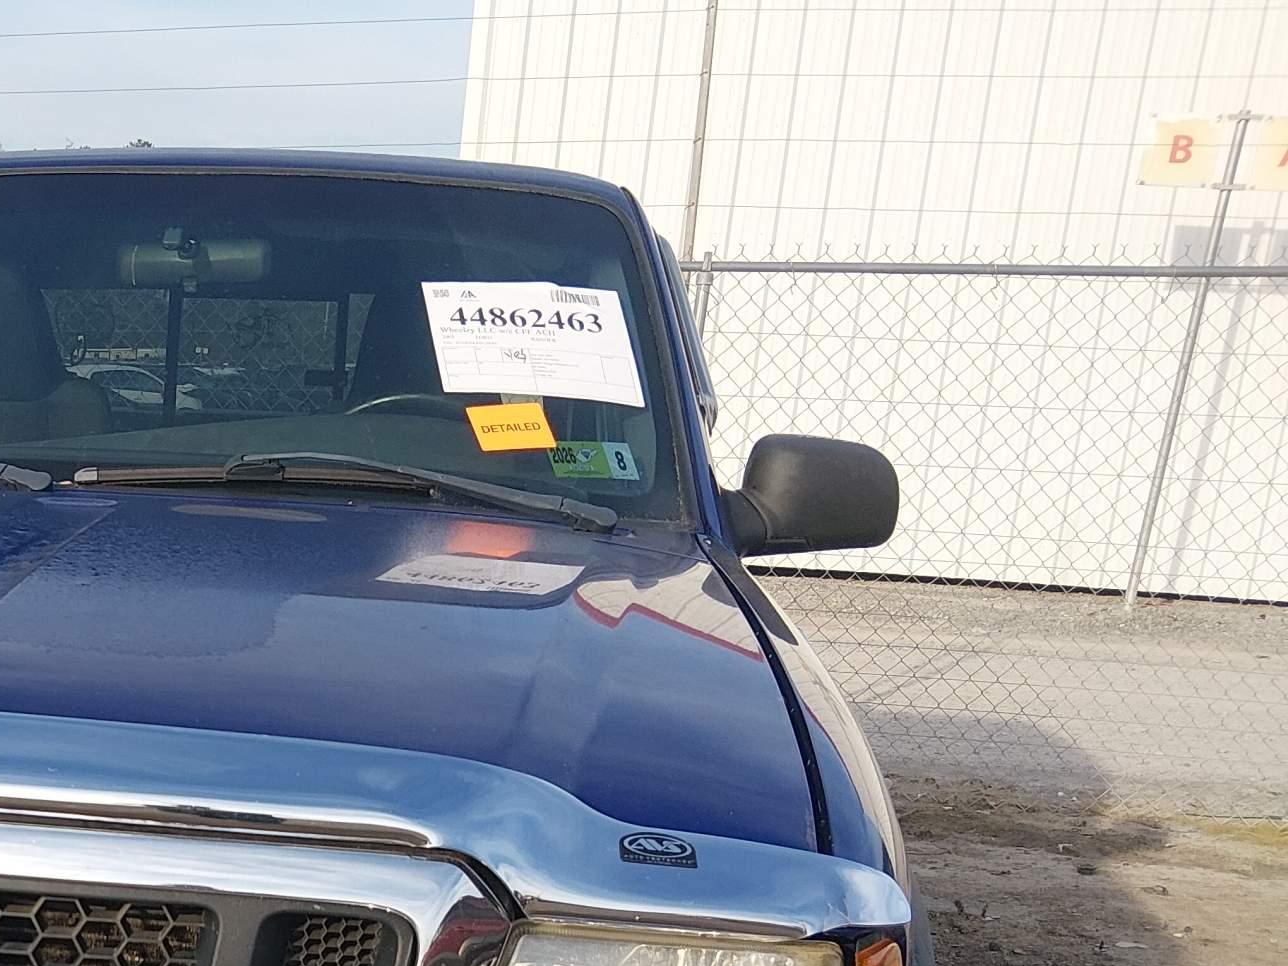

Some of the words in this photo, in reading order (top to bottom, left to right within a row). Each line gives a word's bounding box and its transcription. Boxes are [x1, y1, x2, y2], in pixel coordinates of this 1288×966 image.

[1168, 134, 1195, 164] B
[450, 306, 603, 333] 44862463
[481, 422, 541, 434] DETAILED
[552, 446, 577, 465] 2026
[614, 450, 628, 471] 8
[631, 838, 682, 853] AVS
